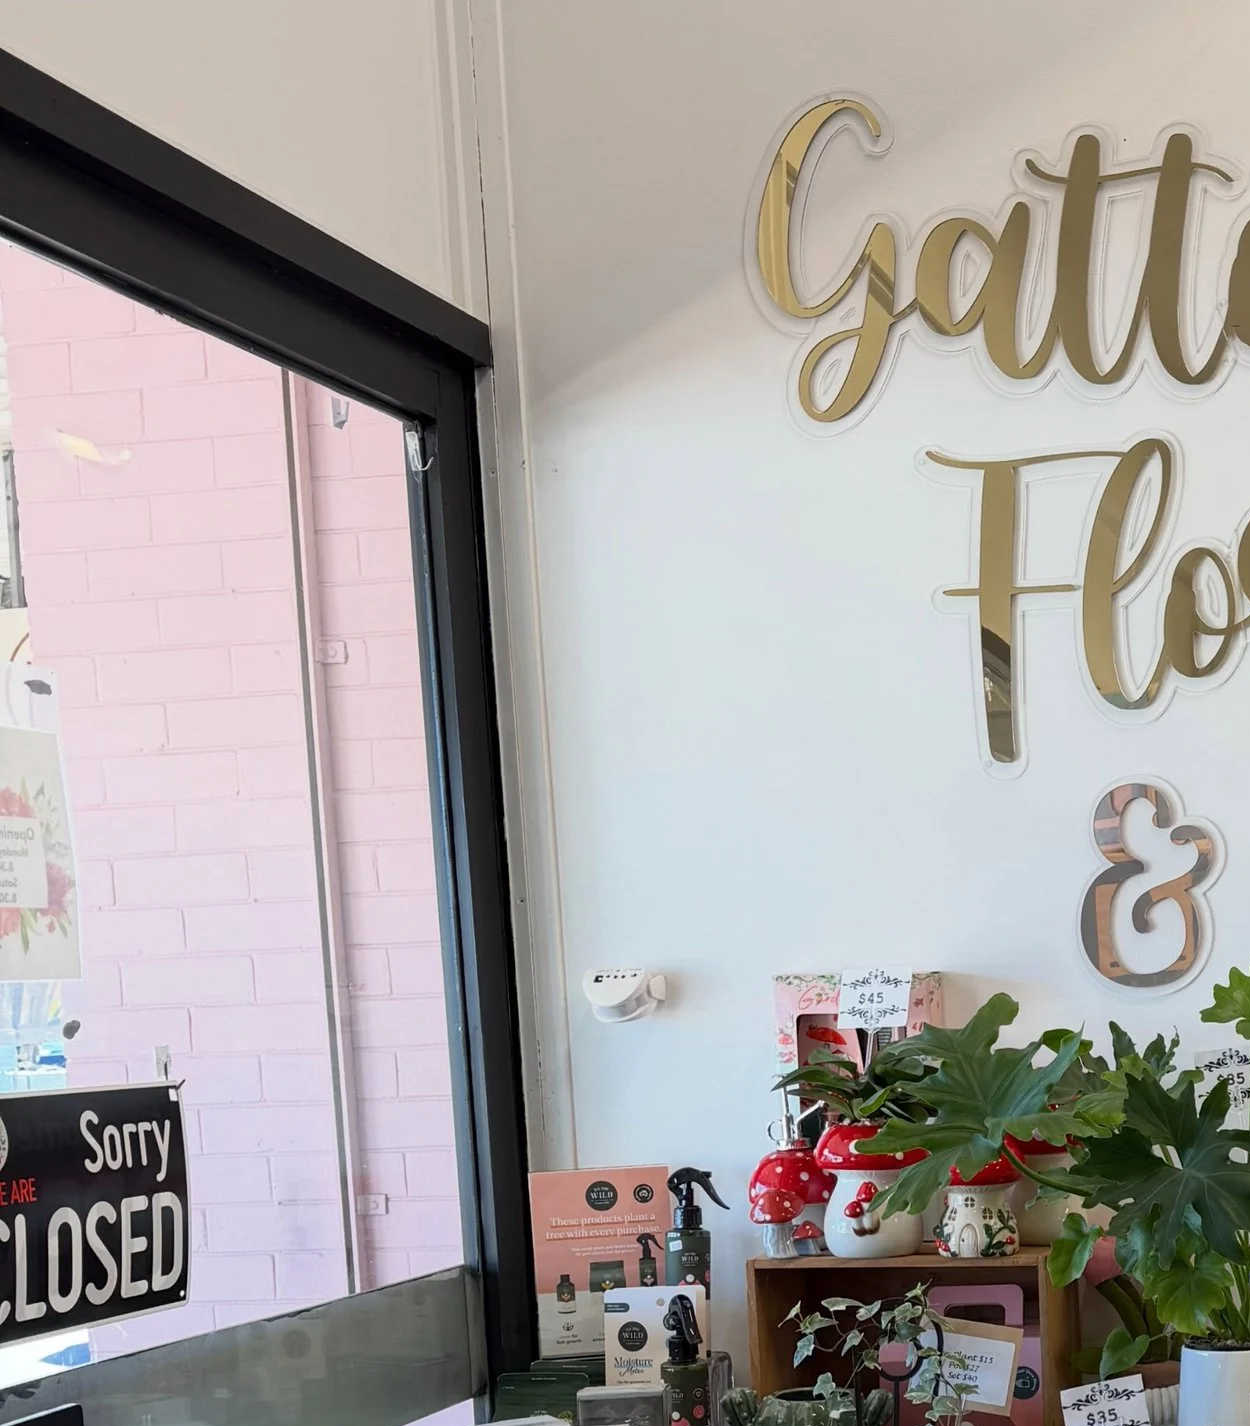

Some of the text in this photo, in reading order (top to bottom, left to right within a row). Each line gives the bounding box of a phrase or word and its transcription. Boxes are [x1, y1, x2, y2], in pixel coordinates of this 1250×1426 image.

[1081, 783, 1211, 986] &
[858, 992, 884, 1004] $45
[80, 1110, 170, 1182] Sorry
[0, 1178, 37, 1206] E ARE
[590, 1191, 614, 1199] WILD
[551, 1217, 579, 1227] These
[581, 1214, 622, 1227] products
[624, 1213, 648, 1224] plant
[546, 1230, 564, 1240] tree
[566, 1229, 588, 1239] with
[589, 1228, 615, 1239] every
[0, 1192, 184, 1326] LOSED
[622, 1331, 644, 1339] WILD
[614, 1357, 653, 1369] Moisture
[1087, 1408, 1118, 1426] $35
